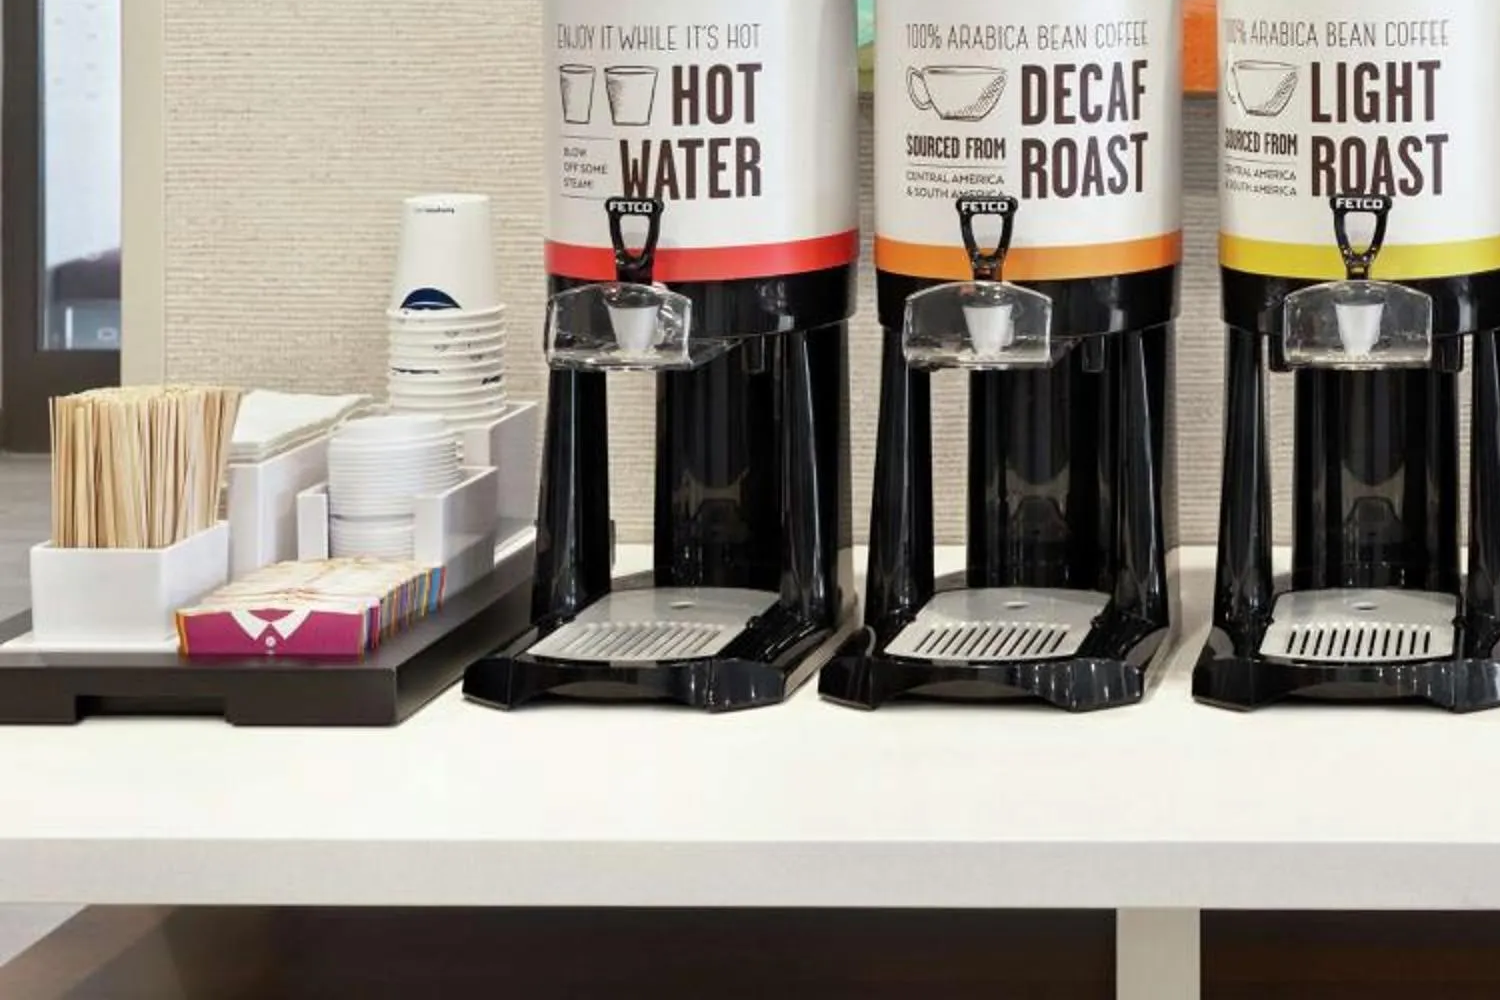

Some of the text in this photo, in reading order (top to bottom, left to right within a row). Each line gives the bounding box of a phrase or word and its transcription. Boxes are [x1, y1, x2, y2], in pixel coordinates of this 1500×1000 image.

[557, 23, 762, 51] ENJOY IT WHILE IT'S HOT
[906, 20, 1149, 50] 100% ARABICA BEAN COFFEE
[1250, 19, 1318, 47] ARABICA
[1326, 21, 1376, 47] BEAN
[1385, 19, 1450, 47] COFFEE
[671, 62, 762, 126] HOT
[1021, 60, 1148, 126] DECAF
[1311, 60, 1441, 124] LIGHT
[906, 134, 1006, 159] SOURCED FROM
[1225, 128, 1297, 156] SOURCED FROM
[619, 137, 762, 200] WATER
[906, 171, 1005, 185] CENTRAL AMERICA
[1021, 132, 1148, 199] ROAST
[1254, 168, 1297, 181] AMERICA
[1311, 133, 1449, 197] ROAST
[914, 187, 949, 198] SOUTH
[1253, 184, 1297, 196] AMERICA
[1336, 198, 1383, 209] FETCO
[609, 202, 653, 212] FETCO
[961, 201, 1008, 212] FETCO
